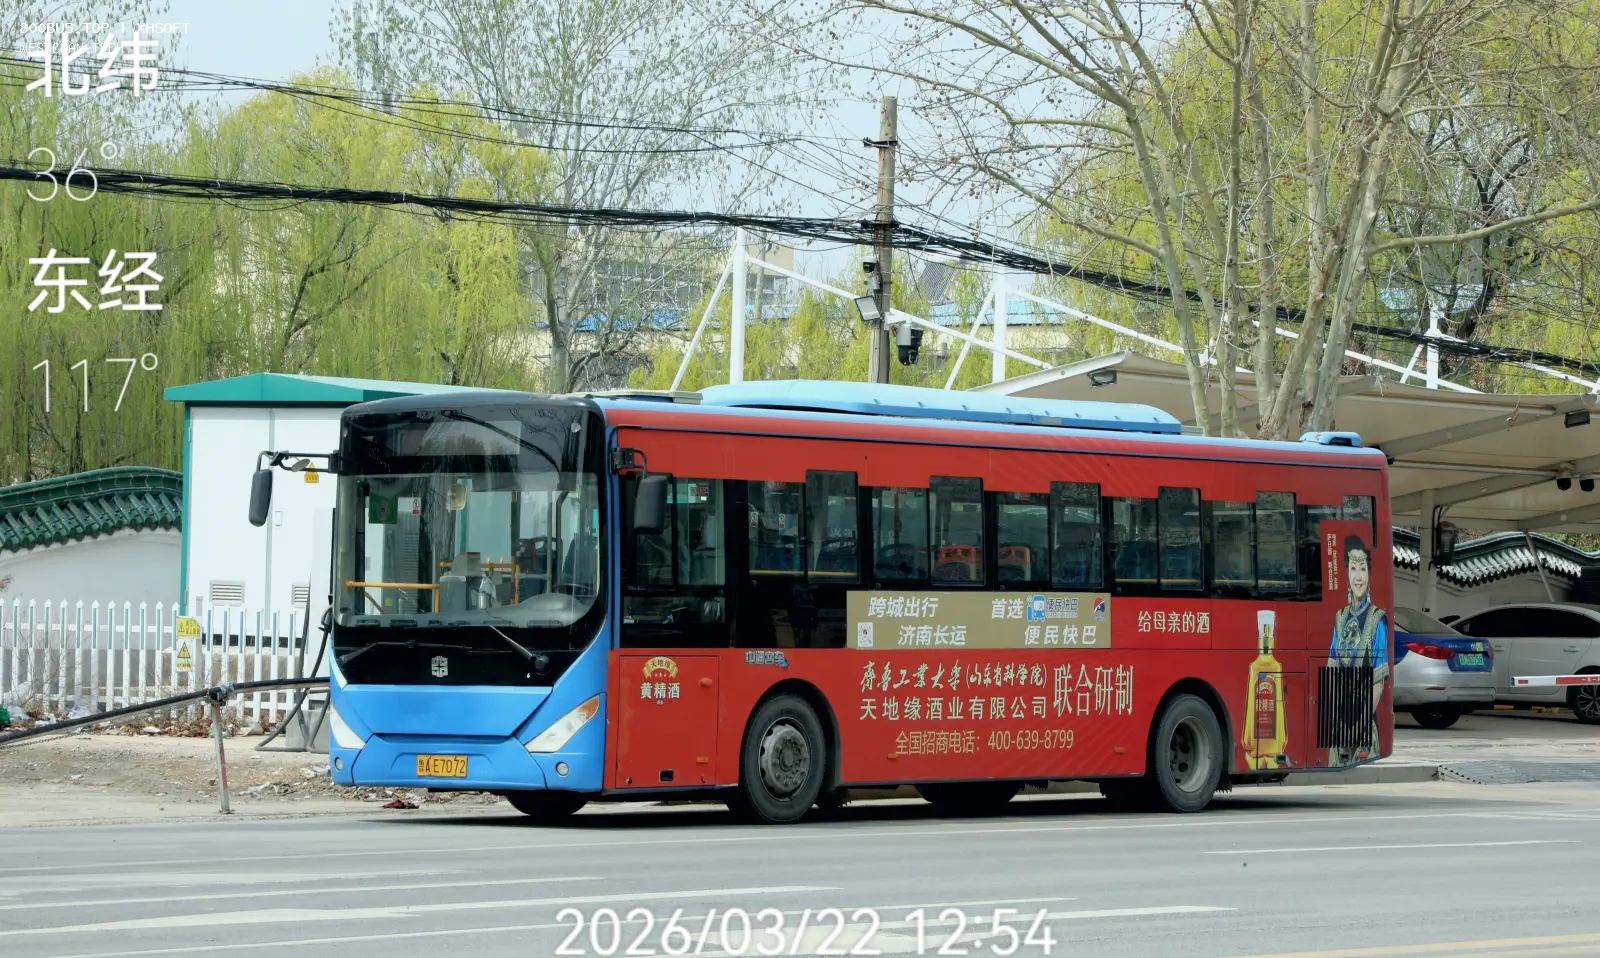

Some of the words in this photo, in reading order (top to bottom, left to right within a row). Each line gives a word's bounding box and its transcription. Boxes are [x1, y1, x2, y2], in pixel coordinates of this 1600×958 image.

[868, 597, 938, 618] 跨城出行
[991, 599, 1024, 619] 首选
[1138, 610, 1210, 633] 给母亲的酒
[898, 625, 967, 646] 济南长运
[1024, 625, 1097, 645] 便民快巴
[640, 682, 680, 699] 黄精酒
[1053, 663, 1134, 717] 联合研制
[859, 696, 1047, 720] 天地缘酒业有限公司
[987, 729, 1074, 750] 400-639-8799
